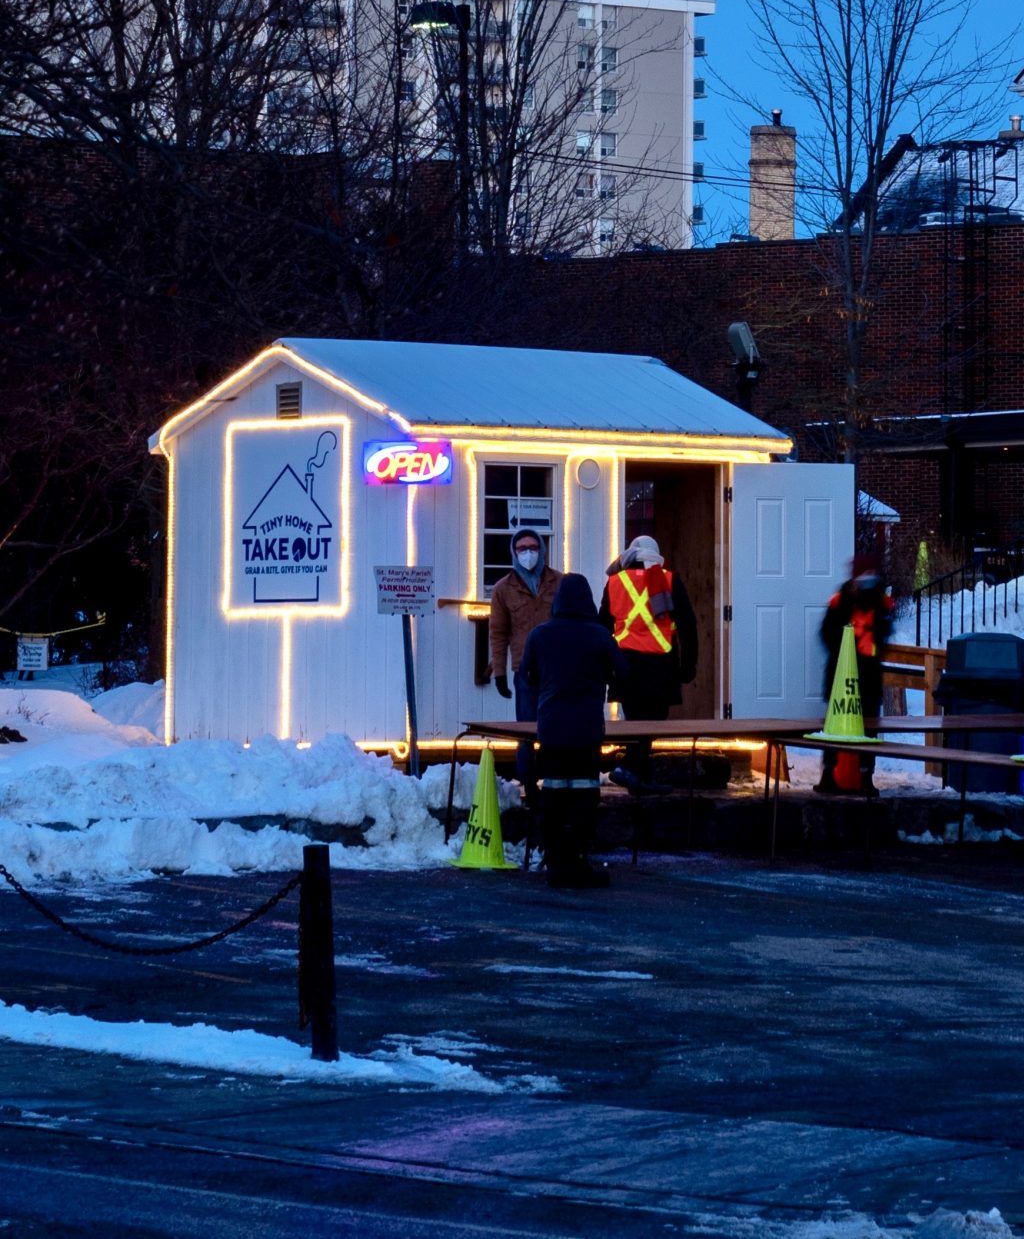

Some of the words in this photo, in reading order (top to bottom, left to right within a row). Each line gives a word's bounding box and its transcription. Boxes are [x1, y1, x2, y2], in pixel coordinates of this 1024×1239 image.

[373, 452, 443, 478] OPEN
[260, 515, 283, 535] TINY
[285, 515, 313, 535] HOME
[245, 566, 260, 574] GRAB
[261, 566, 265, 574] A
[281, 566, 294, 574] GIVE
[295, 565, 301, 573] IF
[302, 565, 313, 573] YOU
[315, 564, 328, 572] CAN
[378, 584, 410, 592] PARKING
